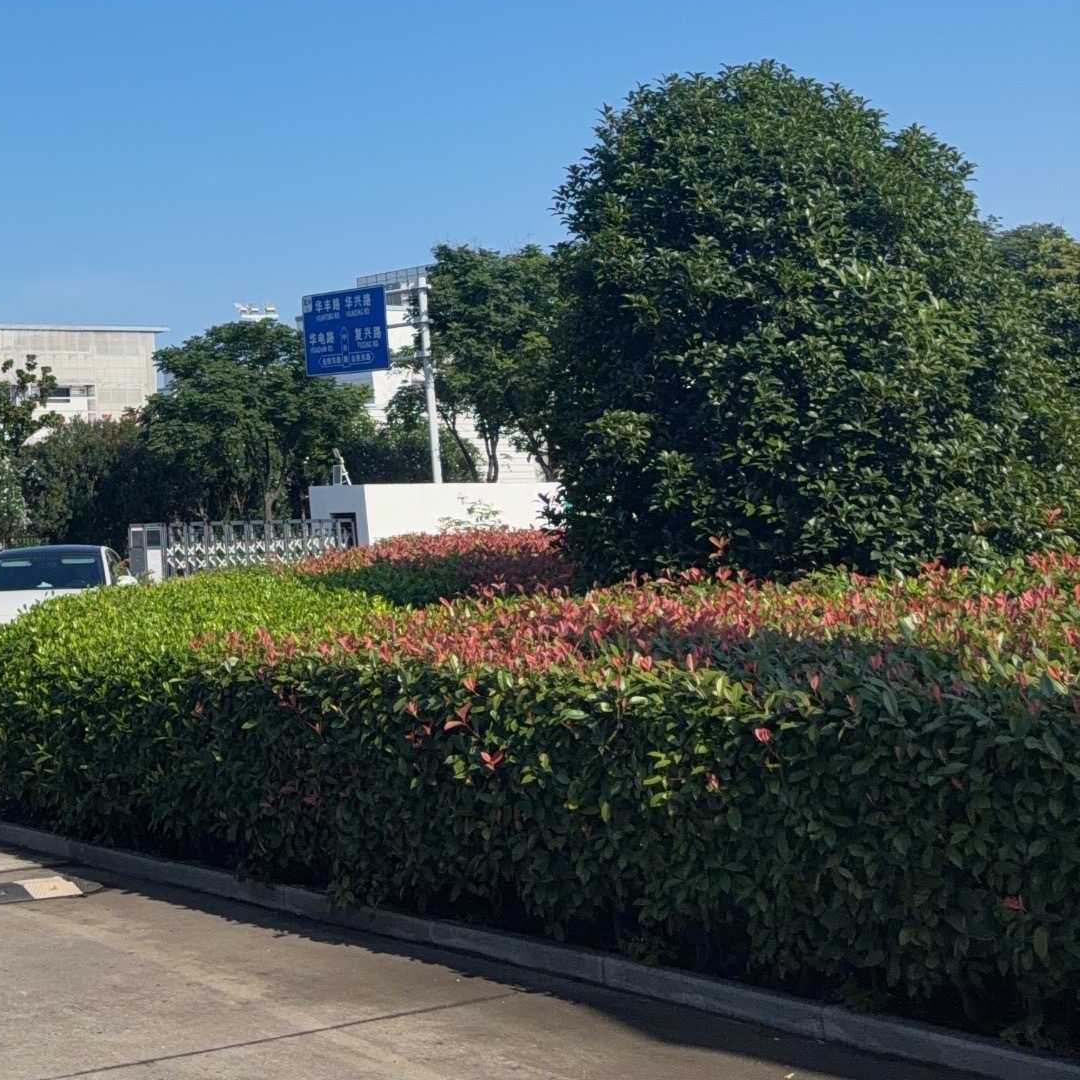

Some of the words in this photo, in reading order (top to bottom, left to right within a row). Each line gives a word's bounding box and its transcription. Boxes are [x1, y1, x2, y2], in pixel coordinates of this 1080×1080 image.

[315, 297, 341, 313] 华丰路
[345, 293, 371, 309] 华兴路
[309, 331, 335, 346] 华电路
[354, 325, 382, 341] 复兴路
